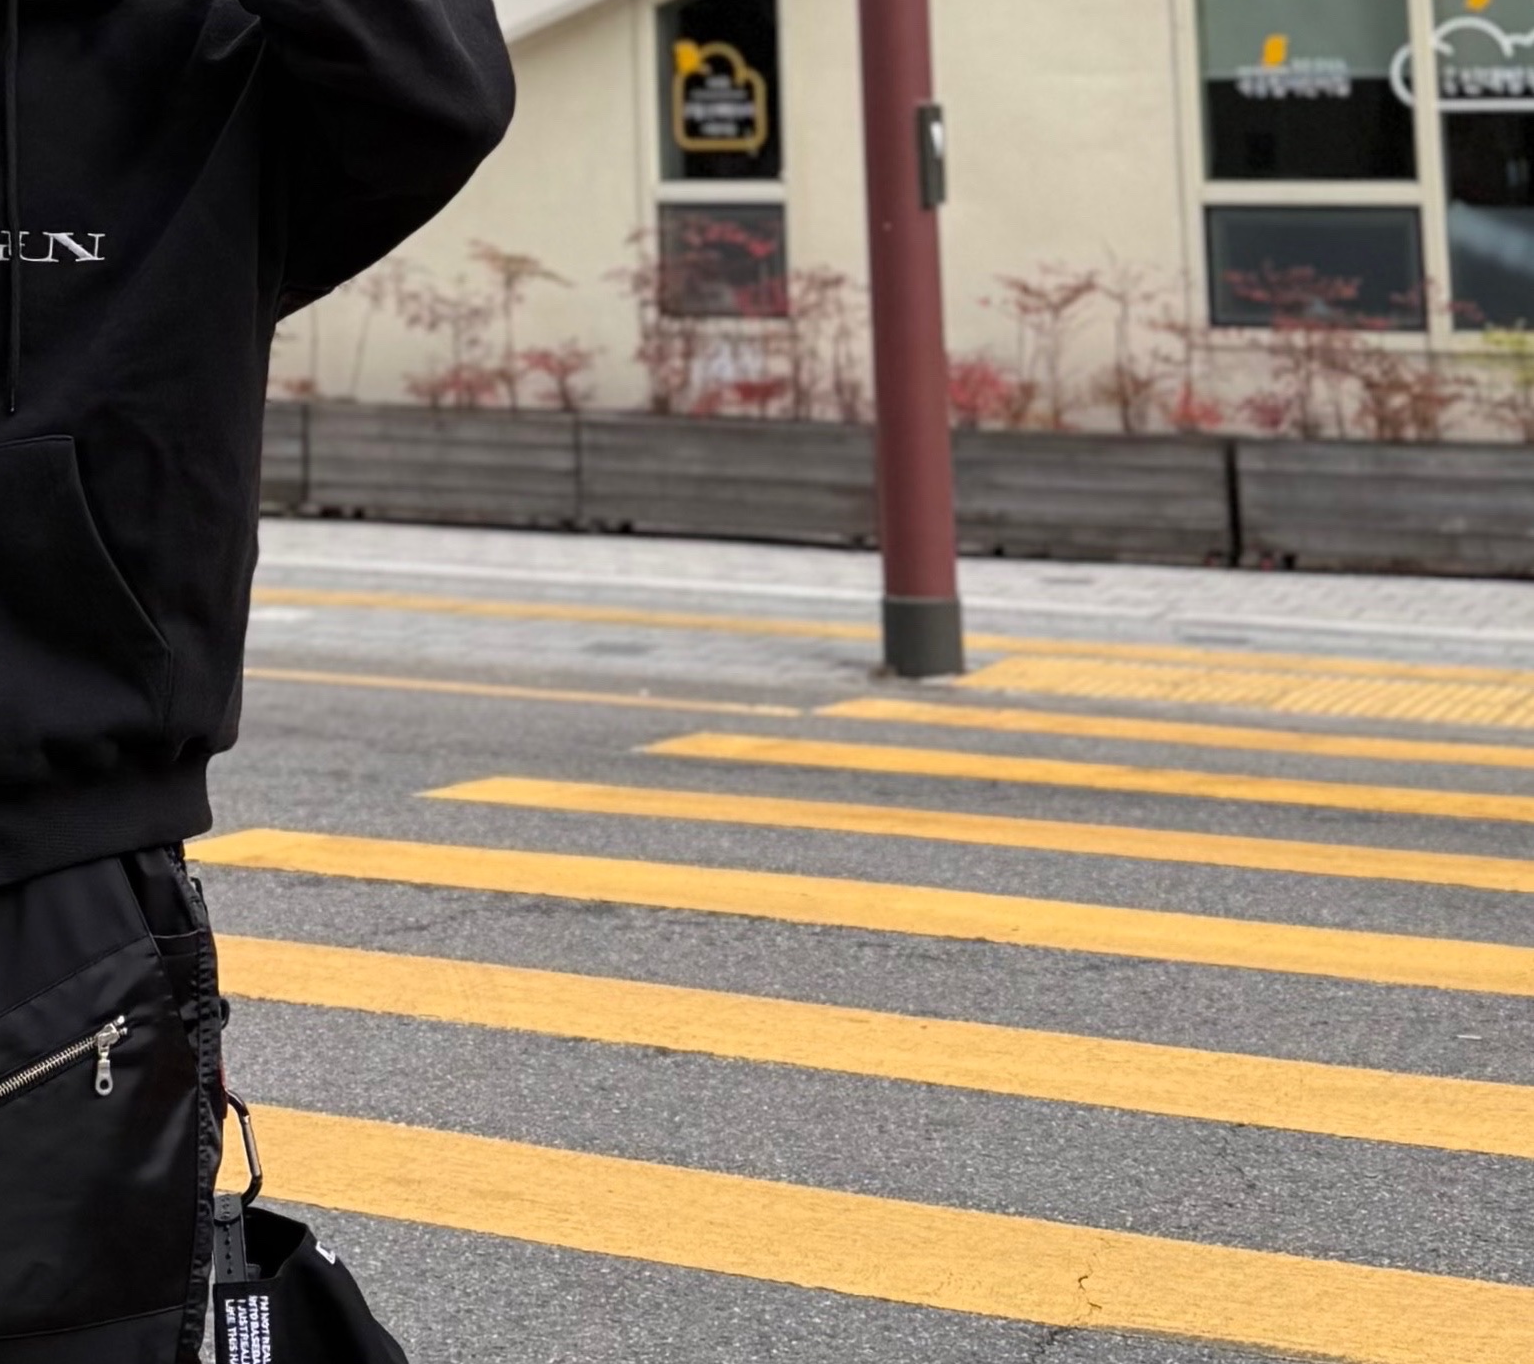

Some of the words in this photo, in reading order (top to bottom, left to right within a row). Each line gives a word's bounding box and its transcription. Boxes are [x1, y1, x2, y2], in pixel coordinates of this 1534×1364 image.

[237, 1305, 248, 1333] JUST
[260, 1312, 270, 1334] NOT
[227, 1327, 239, 1352] THIS
